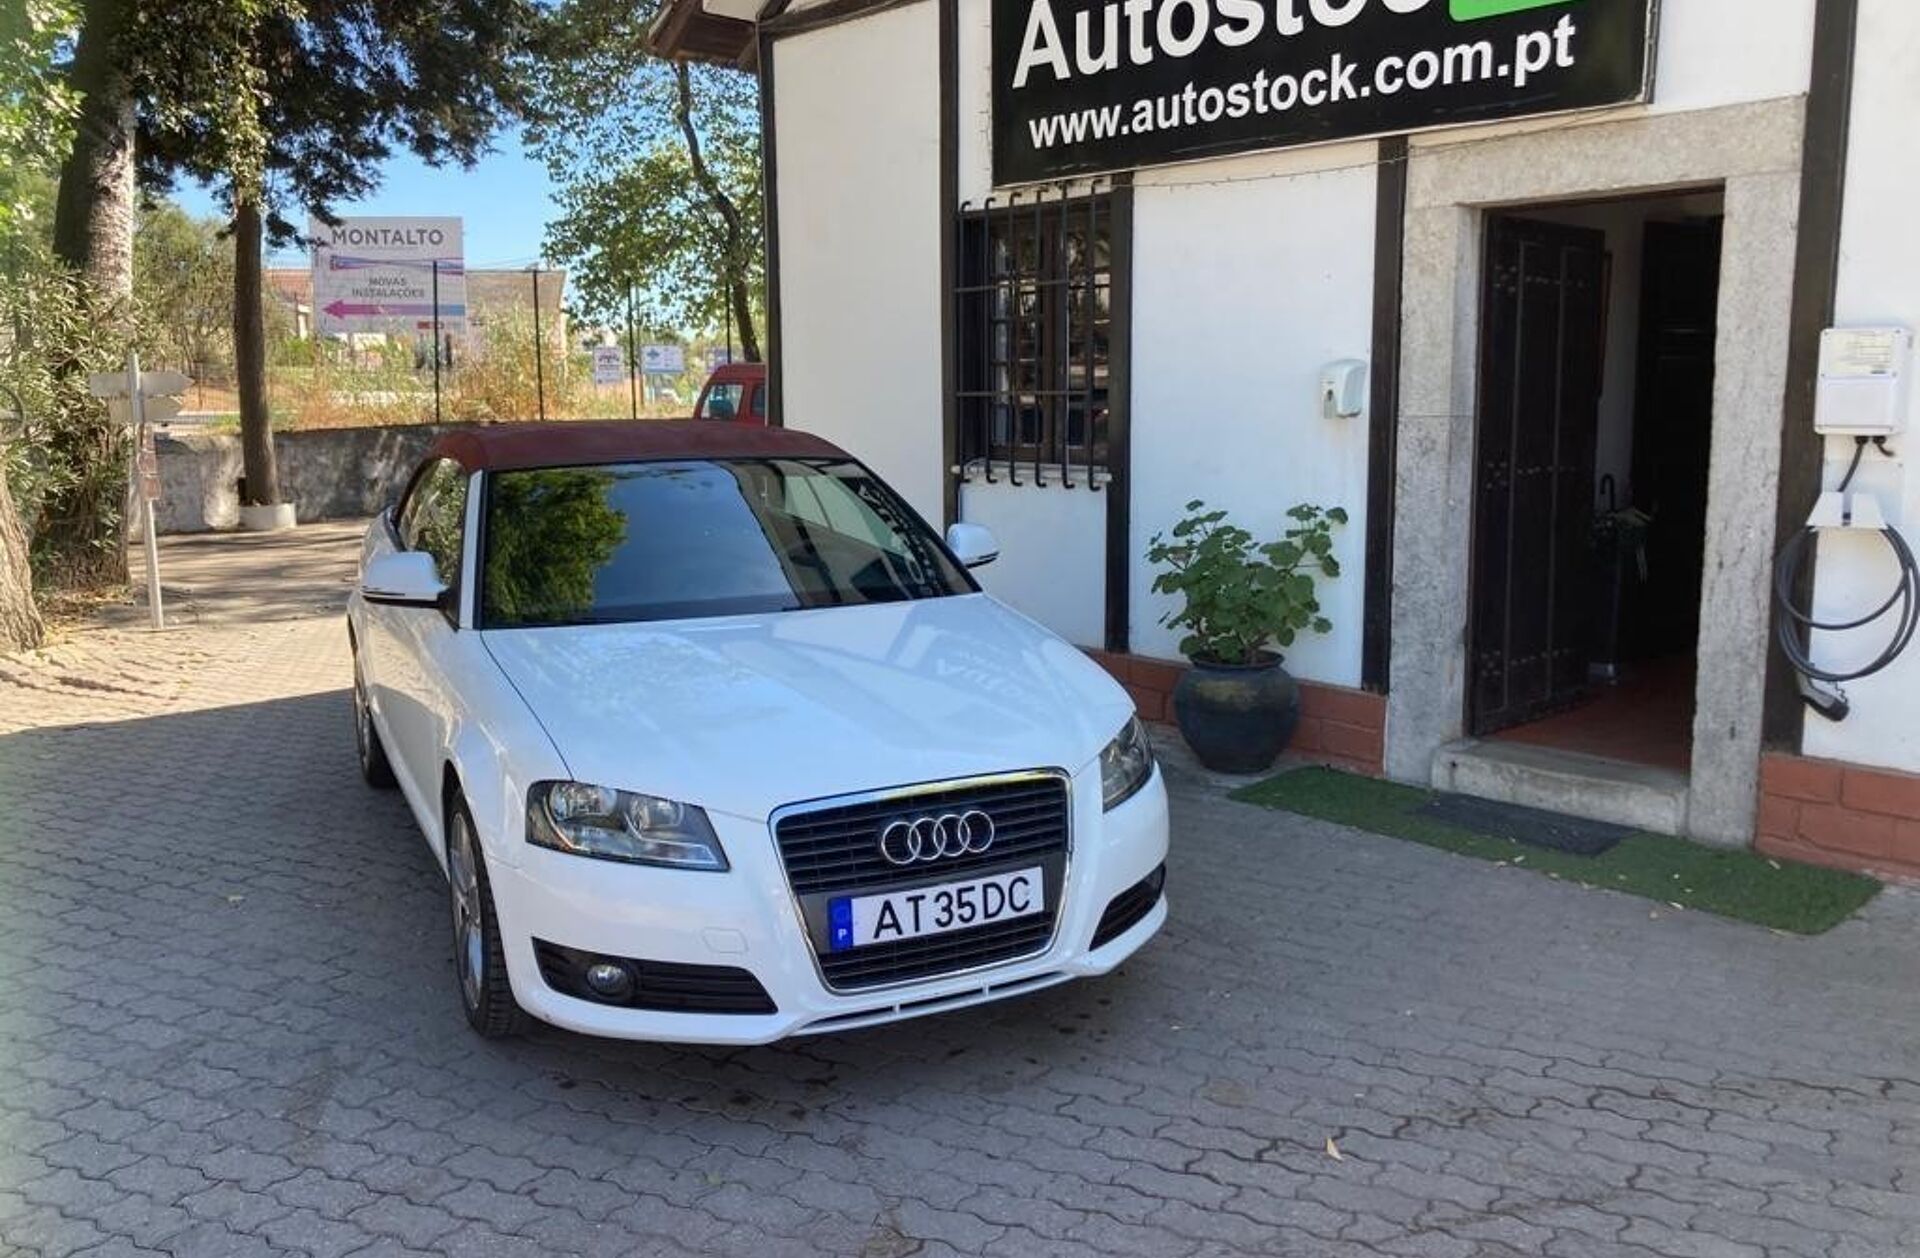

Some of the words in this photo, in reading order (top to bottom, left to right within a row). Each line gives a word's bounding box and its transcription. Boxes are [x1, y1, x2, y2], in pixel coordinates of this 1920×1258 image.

[1028, 13, 1576, 149] www.autostock.com.pt
[331, 228, 444, 246] MONTALTO
[837, 928, 848, 941] P
